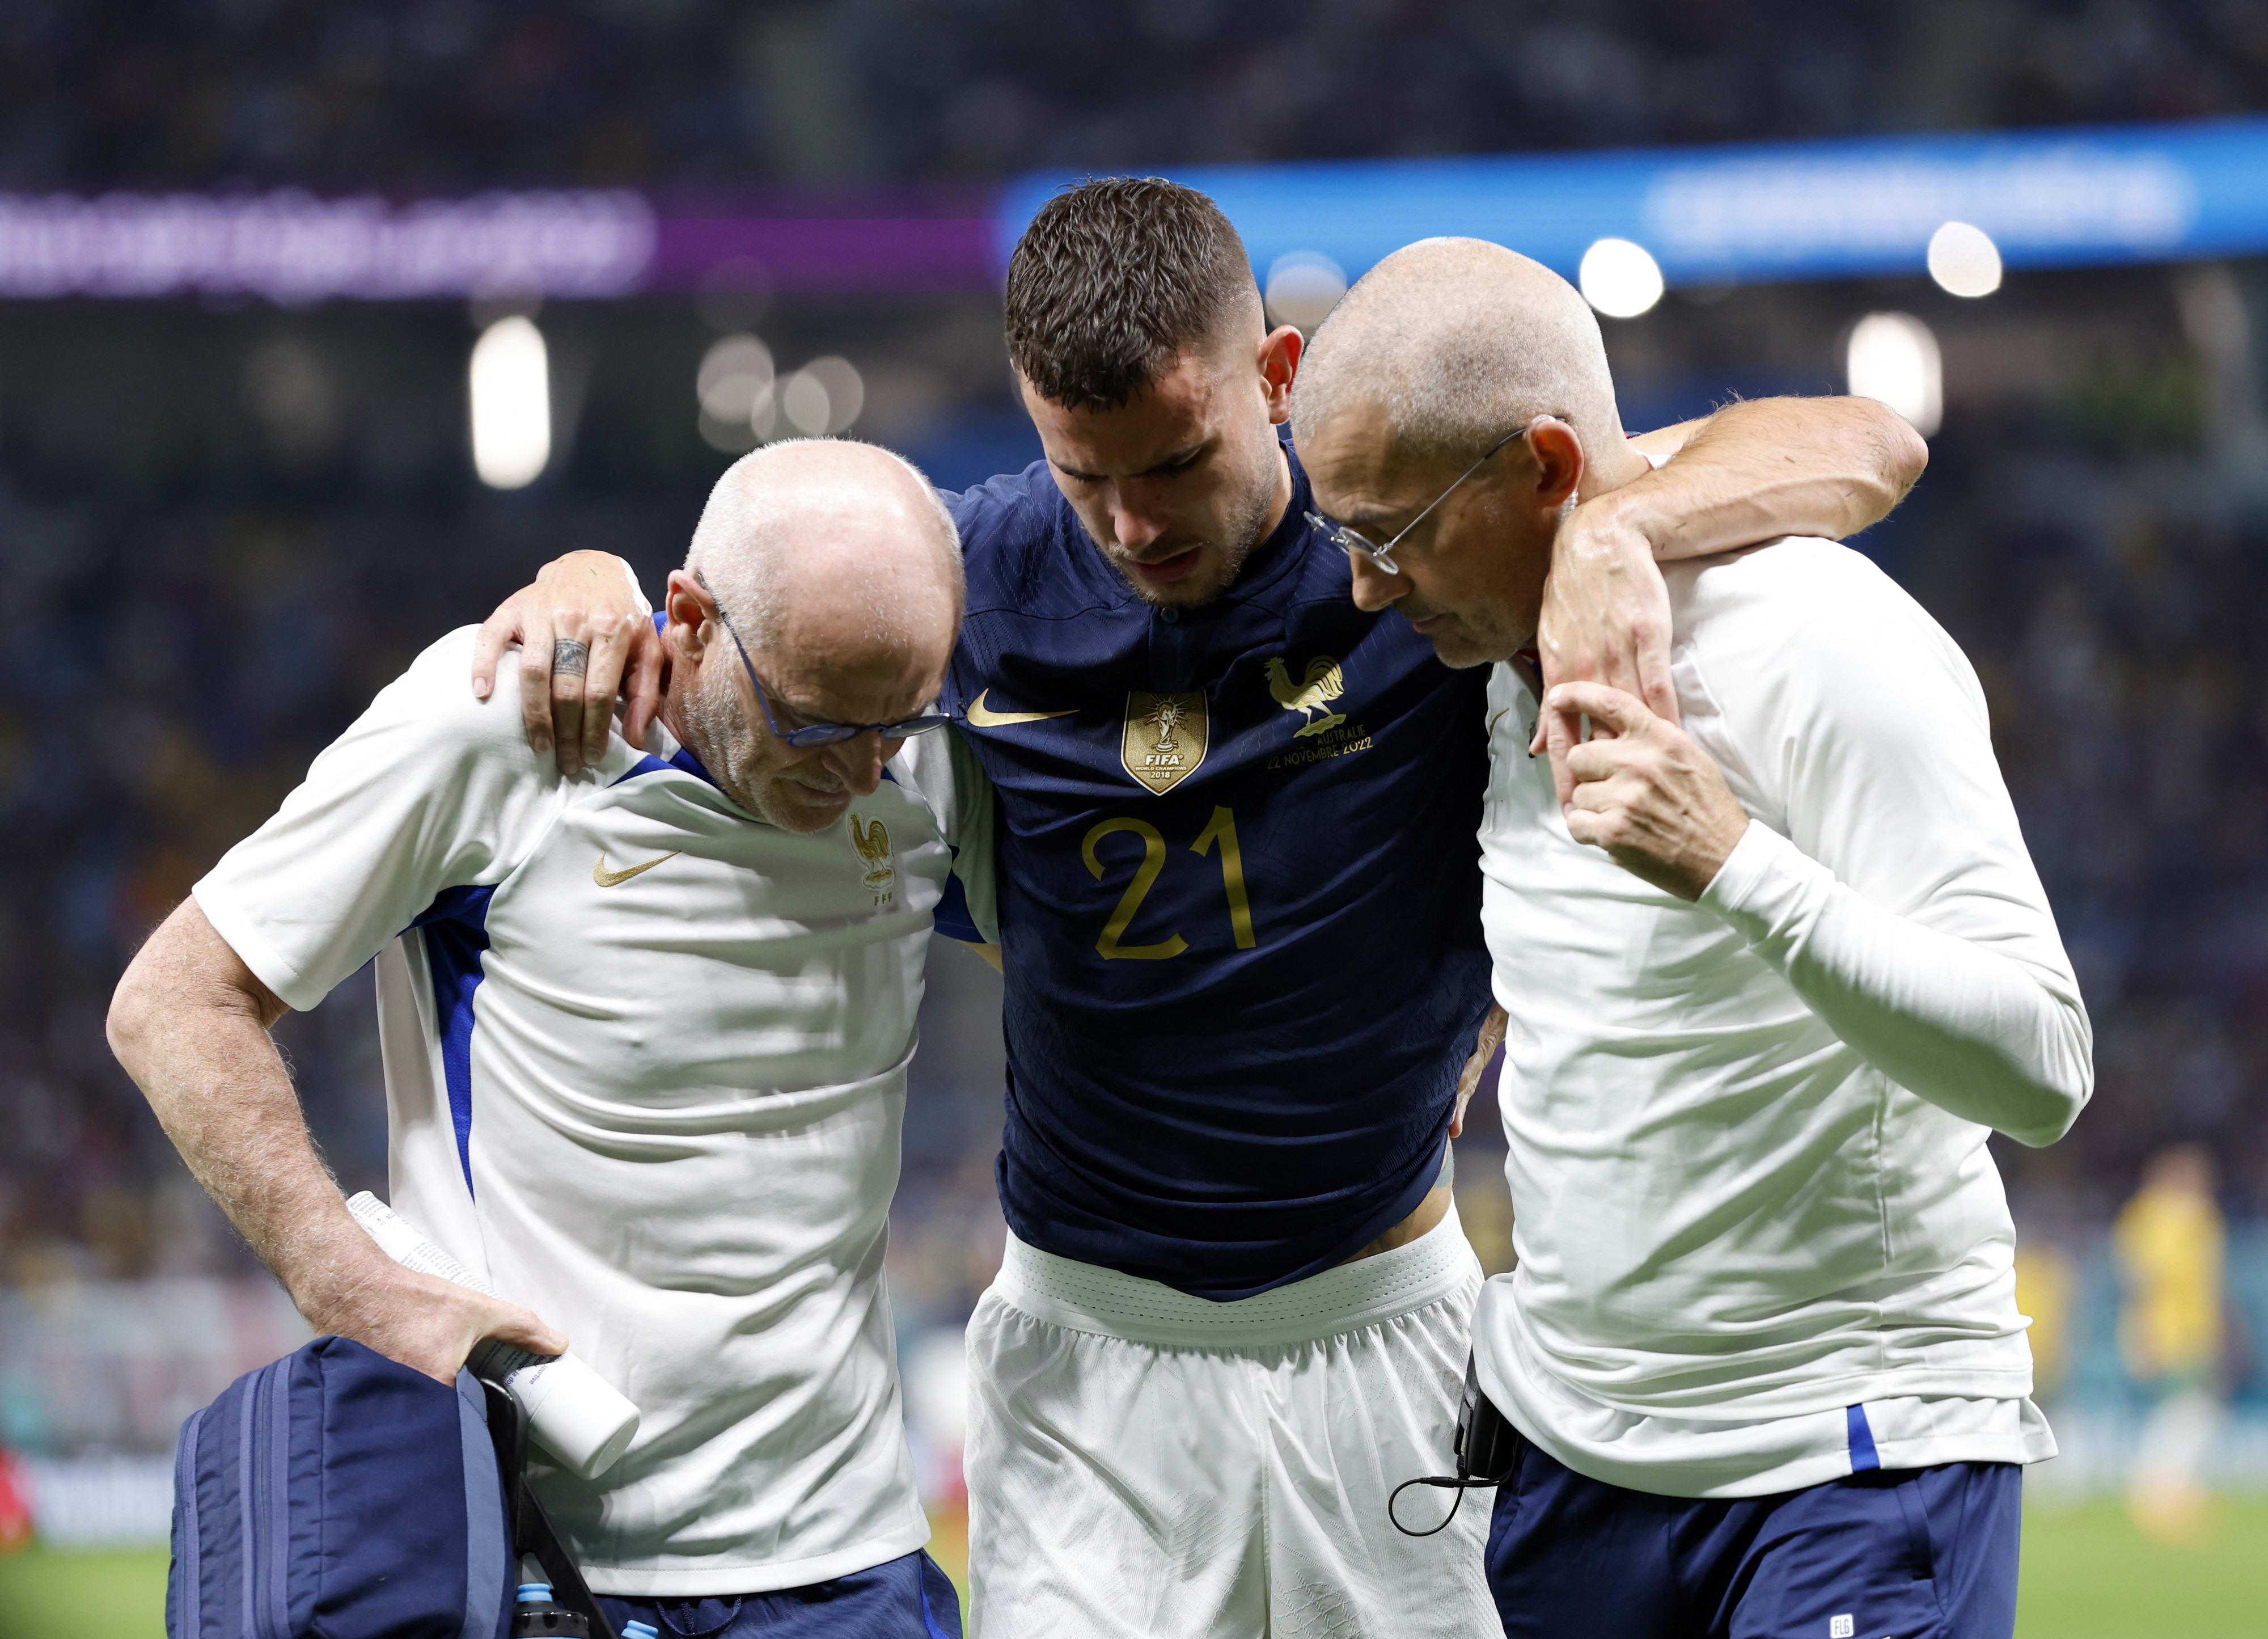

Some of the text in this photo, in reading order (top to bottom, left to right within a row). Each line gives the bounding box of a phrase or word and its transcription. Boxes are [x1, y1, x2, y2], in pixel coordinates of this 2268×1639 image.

[1317, 725, 1366, 746] AUSTRALIE
[1145, 755, 1179, 765] FIFA
[1284, 744, 1339, 766] NOVEMBRE
[1343, 737, 1373, 755] 2022
[1081, 805, 1256, 961] 21
[529, 1365, 548, 1385] sportive
[1835, 1618, 1850, 1635] FLG
